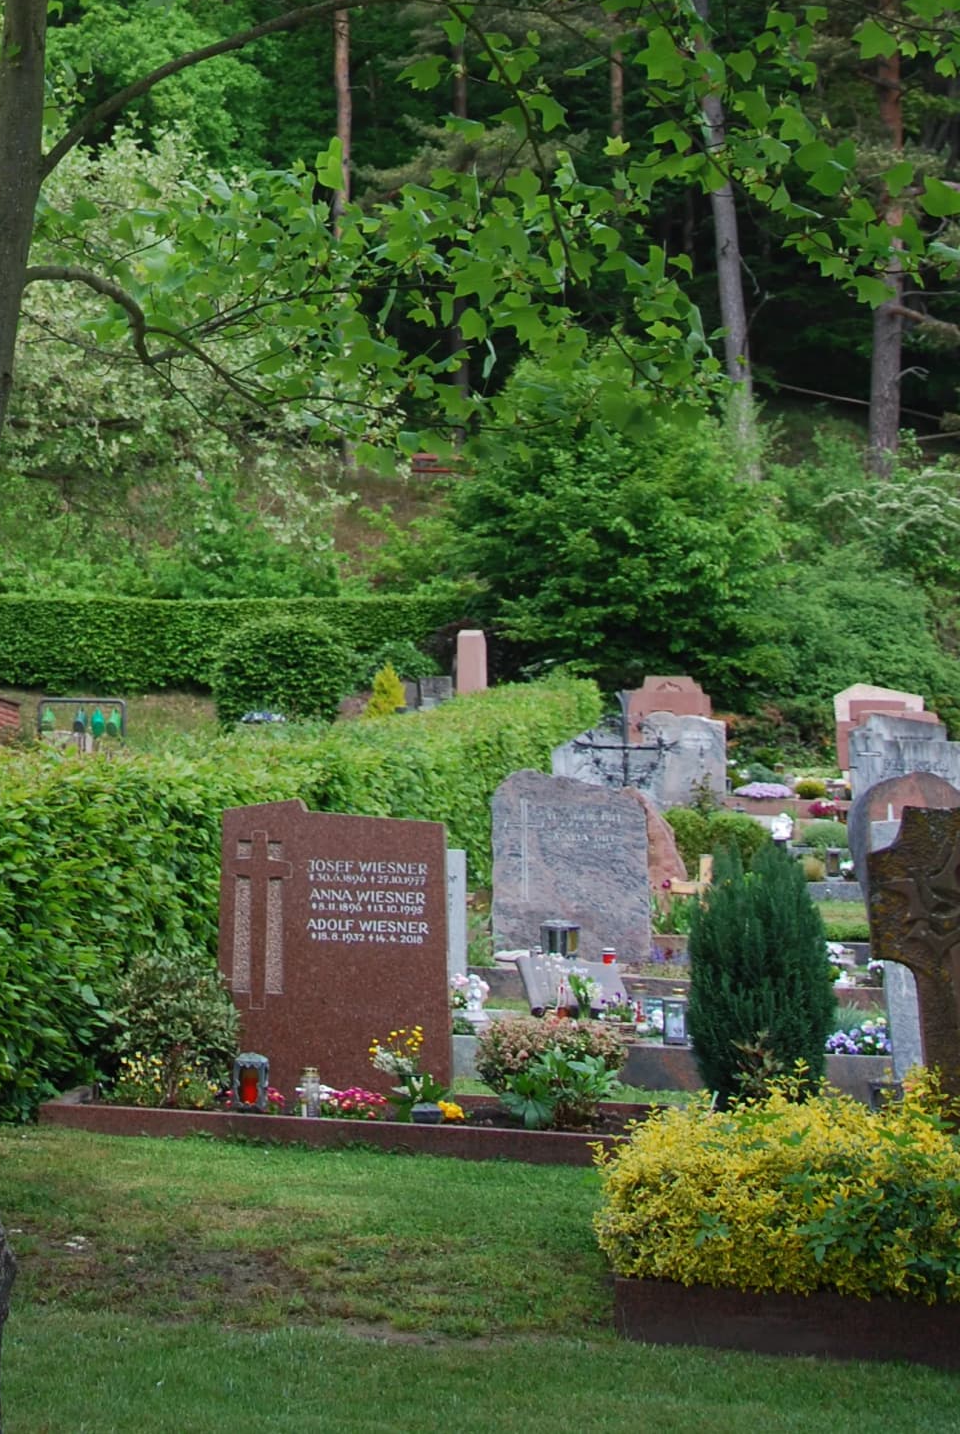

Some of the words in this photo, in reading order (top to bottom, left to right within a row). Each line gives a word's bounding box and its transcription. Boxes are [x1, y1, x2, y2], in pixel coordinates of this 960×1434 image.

[307, 859, 355, 873] JOSEF
[358, 861, 428, 875] WIESNER
[309, 888, 353, 902] ANNA
[356, 889, 426, 904] WIESNER
[306, 918, 355, 932] ADOLF
[358, 919, 429, 935] WIESNER
